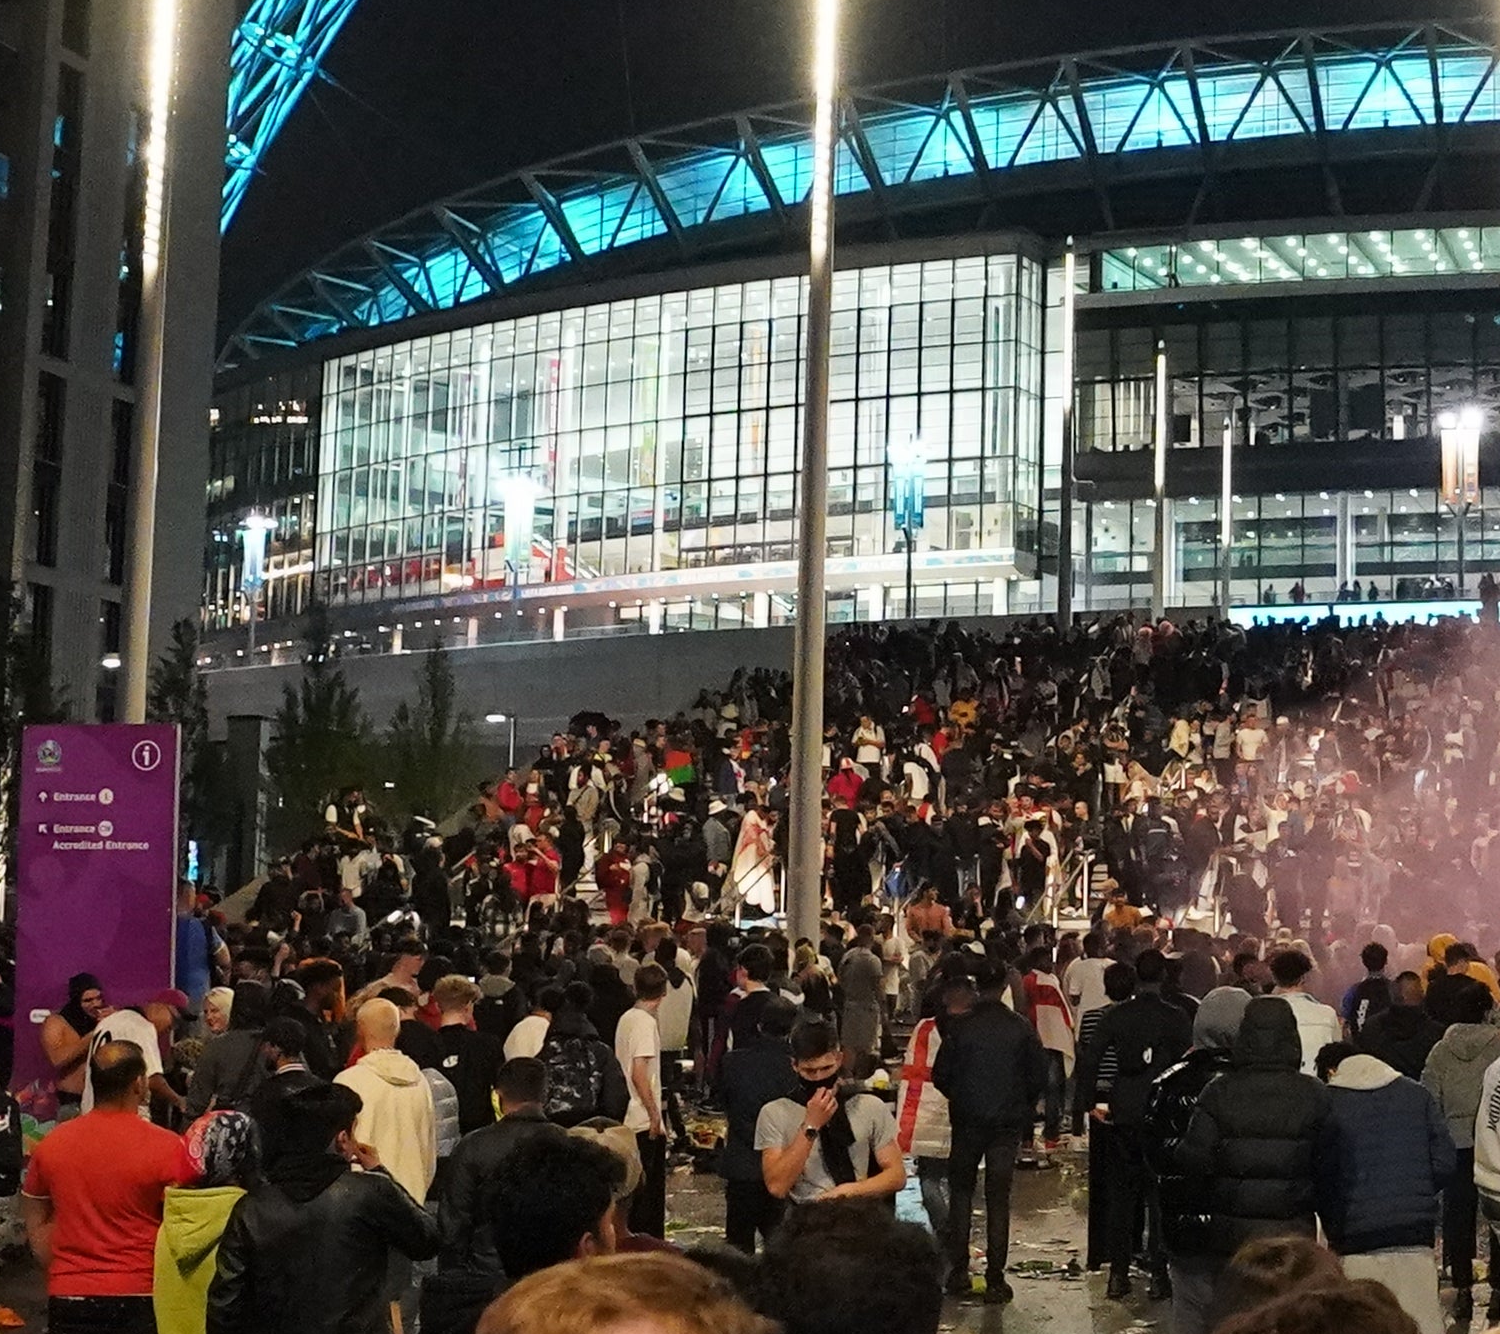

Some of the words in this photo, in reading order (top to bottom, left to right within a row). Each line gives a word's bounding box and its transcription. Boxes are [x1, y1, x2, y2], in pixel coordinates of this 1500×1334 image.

[53, 791, 96, 802] Entrance
[53, 823, 96, 834] Entrance
[52, 840, 104, 850] Accredited
[105, 840, 150, 851] Entrance
